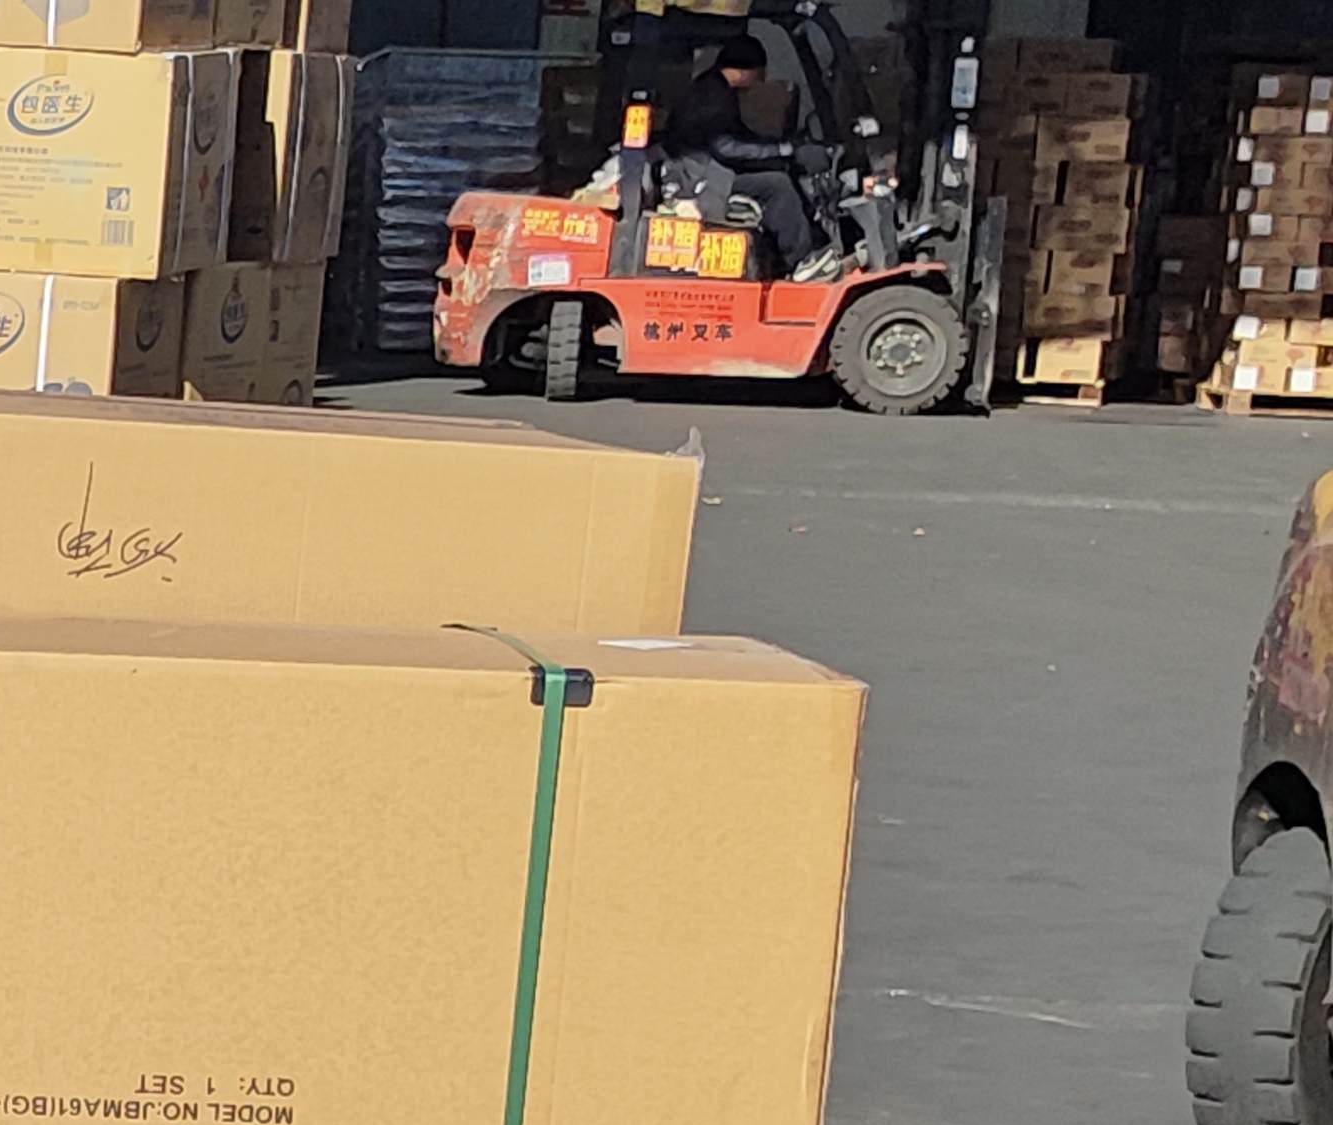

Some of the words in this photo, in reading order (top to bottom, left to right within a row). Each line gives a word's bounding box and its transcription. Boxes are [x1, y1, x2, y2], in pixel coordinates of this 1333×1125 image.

[21, 94, 83, 114] 包医生
[651, 218, 694, 246] 补胎
[701, 234, 743, 275] 补胎
[644, 321, 733, 342] 杭州叉车
[134, 1074, 185, 1095] SET
[207, 1077, 215, 1095] 1
[240, 1077, 295, 1096] QTY:
[207, 1103, 294, 1125] MODEL
